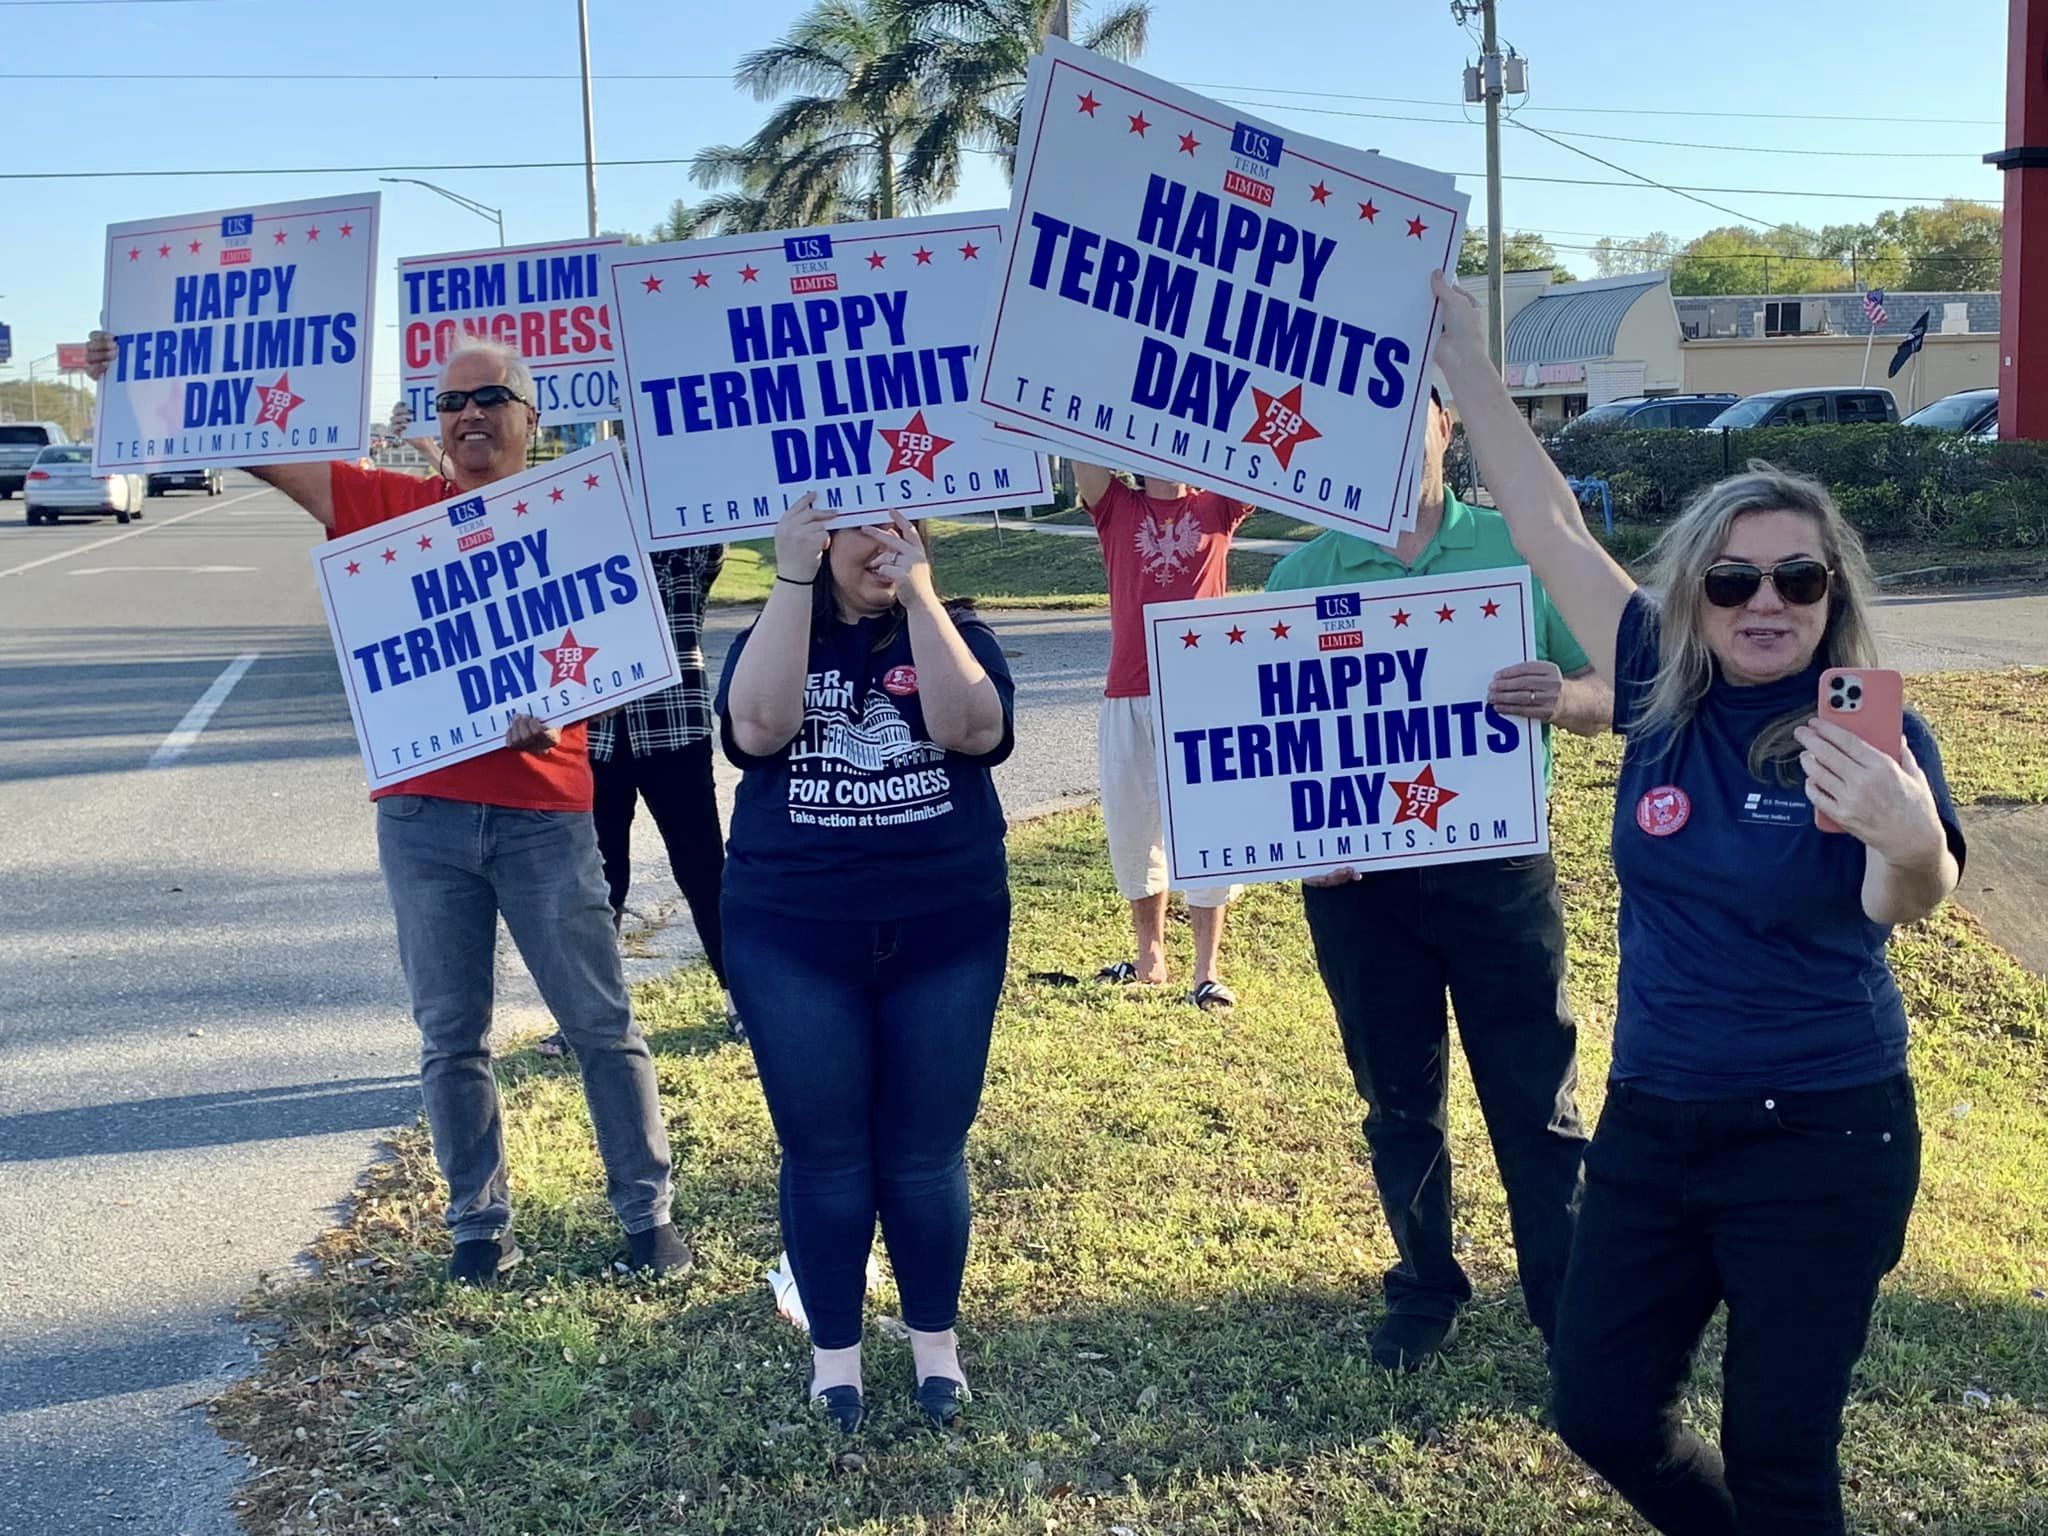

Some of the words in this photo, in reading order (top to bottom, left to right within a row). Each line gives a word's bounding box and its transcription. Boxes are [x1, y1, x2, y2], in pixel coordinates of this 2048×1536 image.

[1242, 129, 1270, 161] U.S.
[1233, 155, 1271, 180] TERM
[1226, 173, 1273, 202] LIMITS
[792, 239, 824, 259] U.S.
[1137, 173, 1337, 302] HAPPY
[792, 261, 828, 274] TERM
[792, 275, 836, 291] LIMITS
[174, 264, 297, 323] HAPPY
[404, 263, 506, 315] TERM
[518, 254, 601, 304] LIMI
[727, 290, 908, 363] HAPPY
[1029, 212, 1198, 339] TERM
[1203, 278, 1411, 409] LIMITS
[114, 326, 214, 382] TERM
[222, 312, 356, 373] LIMITS
[266, 389, 291, 407] FEB
[641, 364, 806, 437] TERM
[816, 344, 979, 418] LIMIT
[1131, 337, 1251, 433] DAY
[184, 377, 254, 429] DAY
[264, 404, 282, 421] 27
[1264, 403, 1303, 436] FEB
[117, 426, 339, 457] TERMLIMITS.COM
[771, 419, 875, 485] DAY
[898, 431, 933, 452] FEB
[1016, 377, 1361, 510] TERMLIMITS.COM
[1257, 424, 1288, 448] 27
[899, 449, 925, 468] 27
[459, 529, 493, 550] LIMITS
[411, 528, 552, 621] HAPPY
[1324, 597, 1352, 617] U.S.
[353, 612, 482, 694] TERM
[485, 554, 639, 651] LIMITS
[1322, 619, 1356, 631] TERM
[555, 647, 582, 664] FEB
[1321, 633, 1361, 648] LIMITS
[457, 645, 538, 715] DAY
[558, 662, 578, 679] 27
[1258, 647, 1429, 717] HAPPY
[1174, 718, 1323, 785] TERM
[1337, 700, 1520, 769] LIMITS
[789, 778, 830, 804] FOR
[835, 768, 950, 805] CONGRESS
[1290, 772, 1386, 832] DAY
[1406, 784, 1438, 802] FEB
[789, 810, 816, 824] Take
[817, 813, 856, 827] action
[858, 814, 874, 827] at
[875, 801, 953, 826] termlimits.com
[1407, 801, 1430, 818] 27
[1200, 820, 1508, 868] TERMLIMITS.COM
